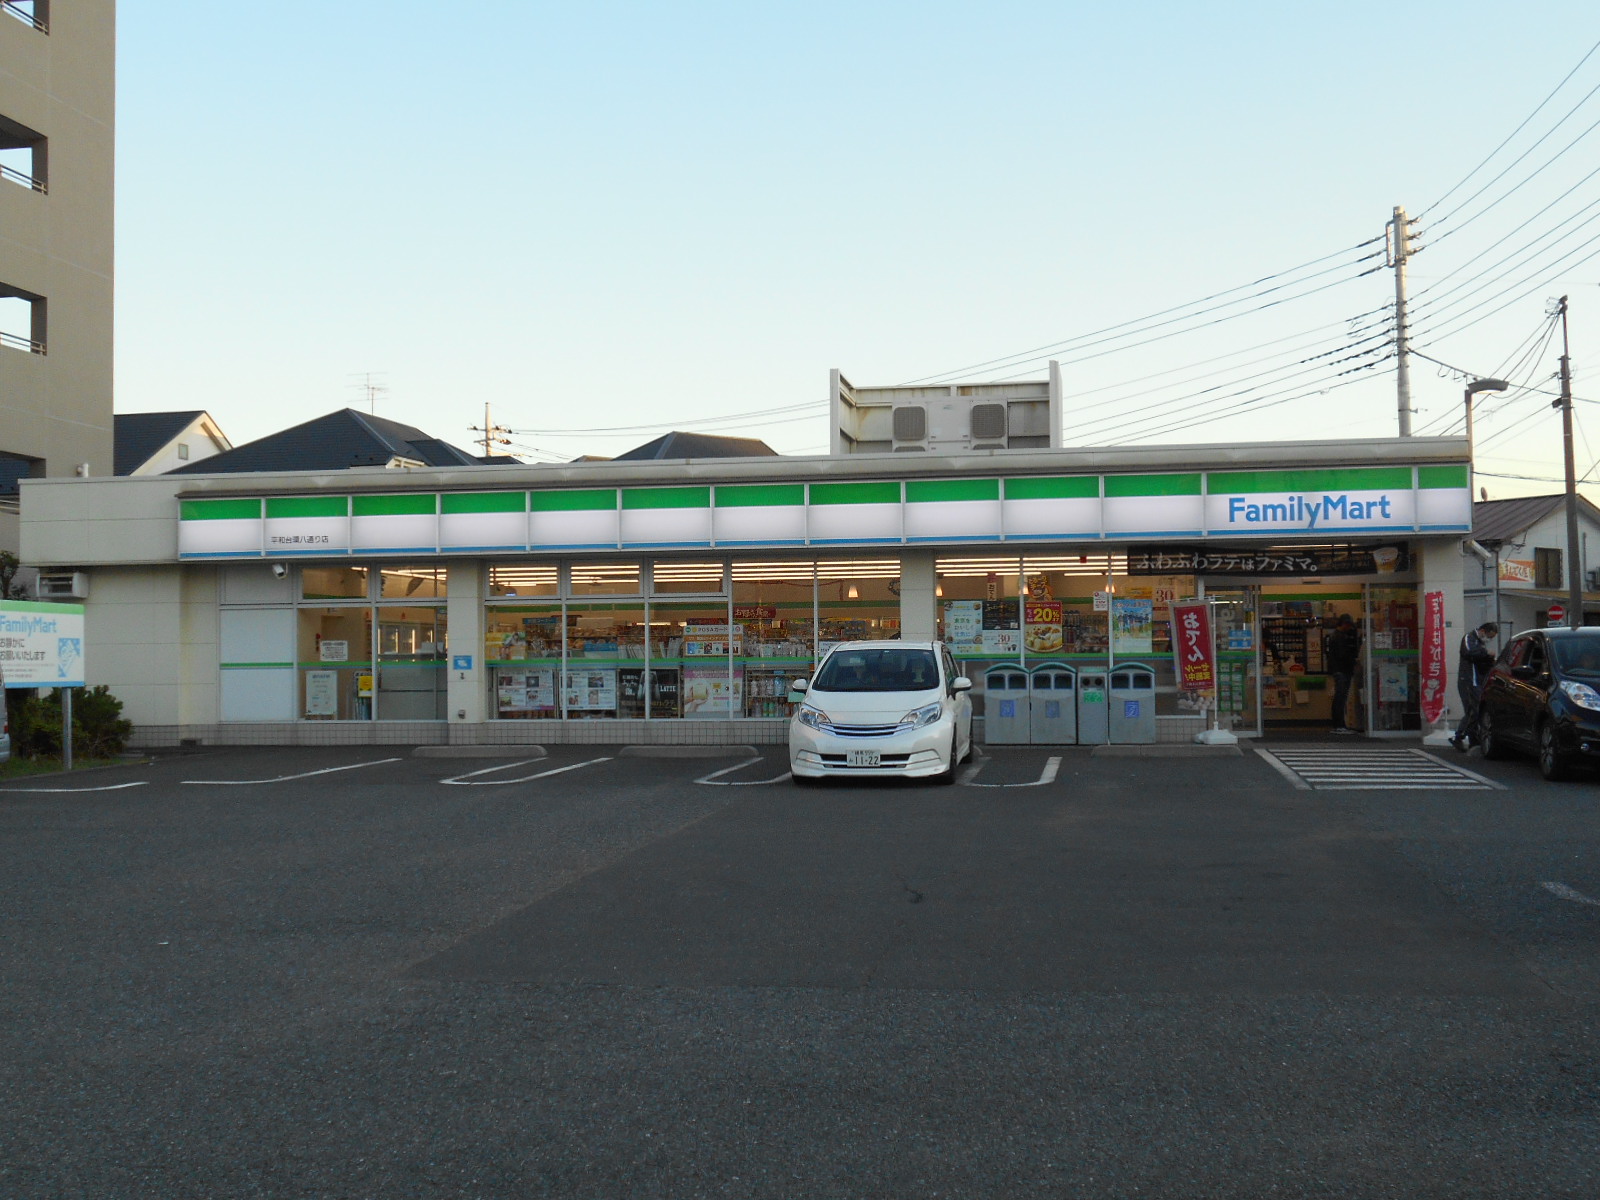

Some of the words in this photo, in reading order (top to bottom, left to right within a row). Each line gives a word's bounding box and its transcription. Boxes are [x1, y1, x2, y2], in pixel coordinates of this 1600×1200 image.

[1229, 495, 1391, 528] FamilyMart
[0, 615, 57, 637] FamilyMart
[855, 756, 879, 765] 11-22
